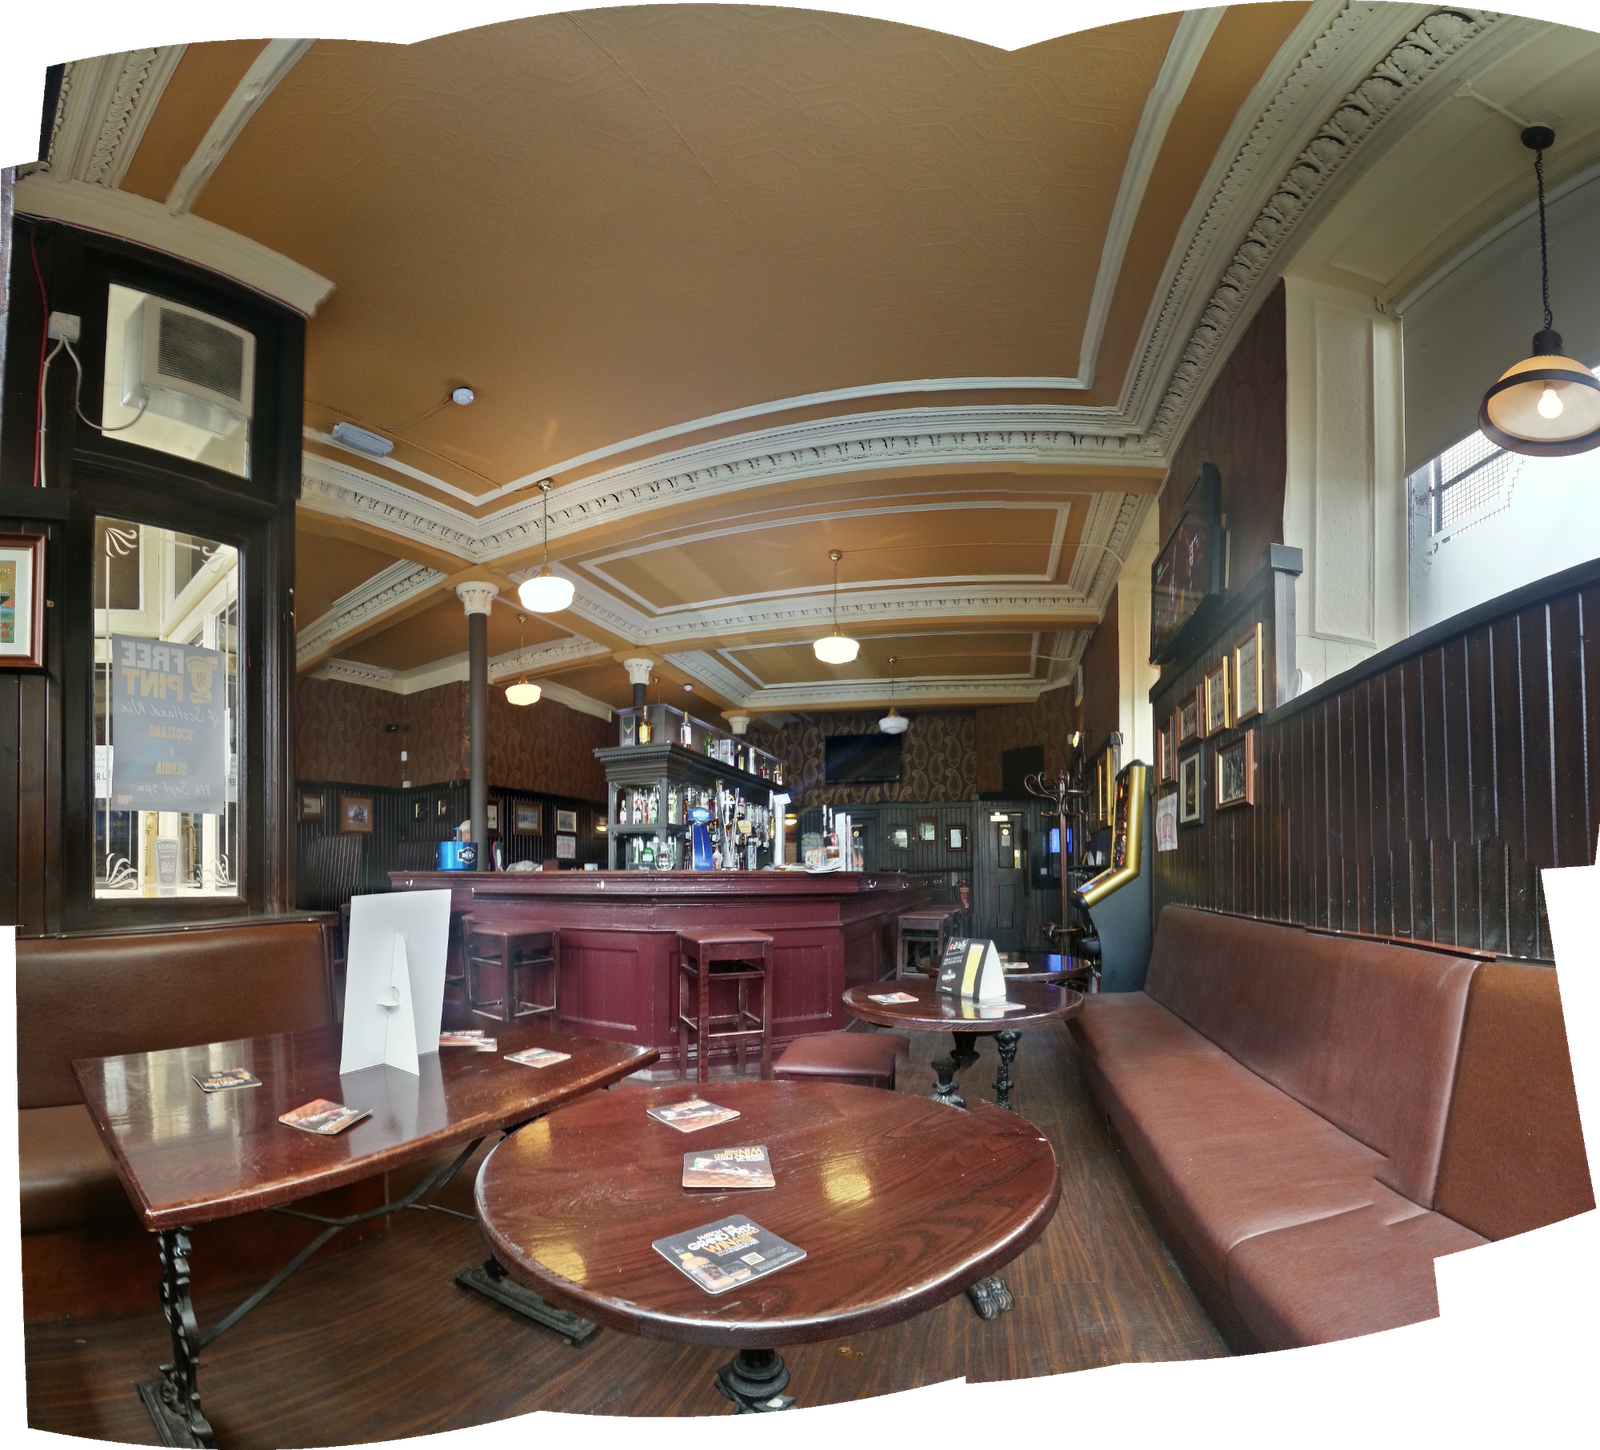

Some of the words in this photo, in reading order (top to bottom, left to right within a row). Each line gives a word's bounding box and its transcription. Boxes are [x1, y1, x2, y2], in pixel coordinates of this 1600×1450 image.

[738, 1147, 763, 1155] WIN
[687, 1233, 729, 1251] GRAND
[726, 1223, 756, 1237] PRIX
[703, 1238, 738, 1254] WIN
